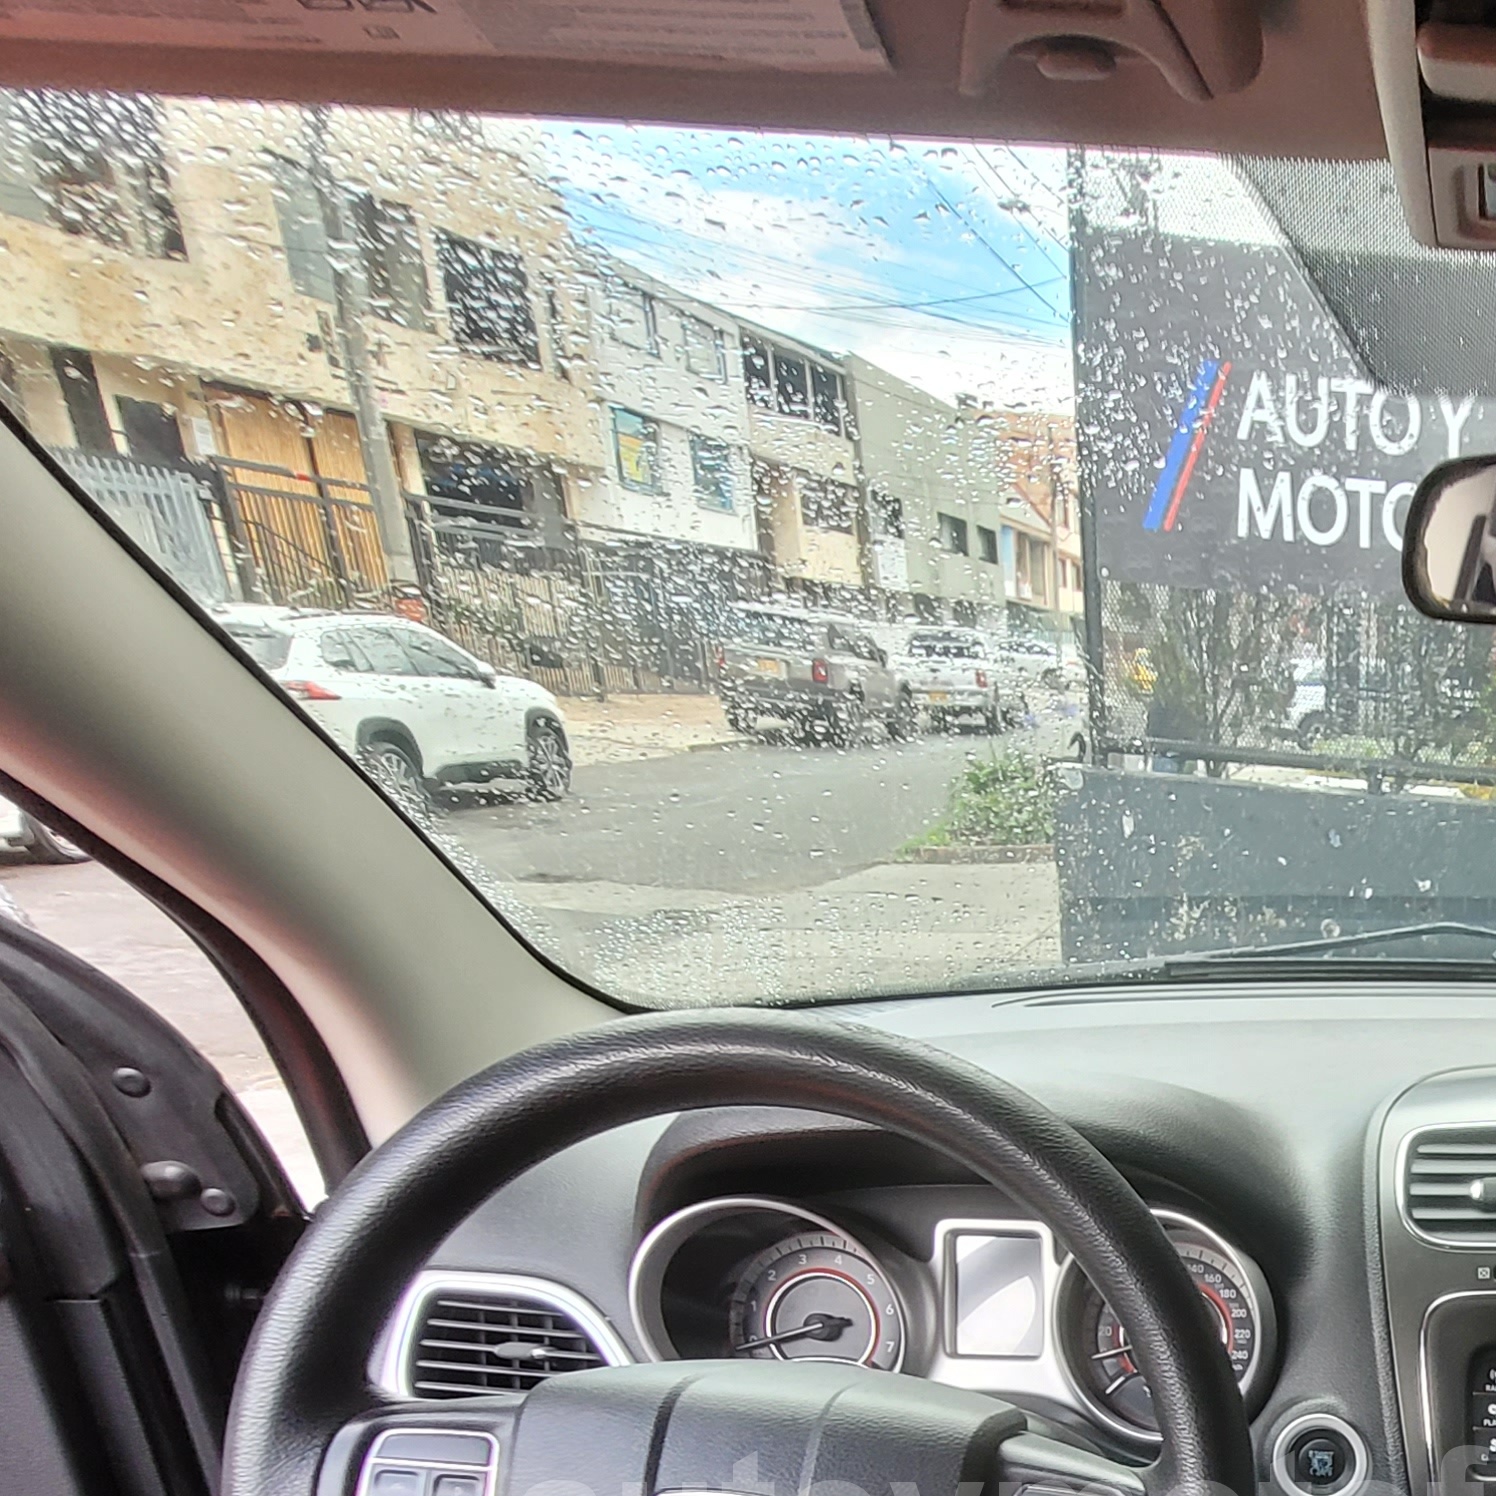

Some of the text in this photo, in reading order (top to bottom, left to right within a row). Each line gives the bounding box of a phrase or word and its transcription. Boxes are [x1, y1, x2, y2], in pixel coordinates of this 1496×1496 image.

[1236, 368, 1476, 460] AUTO Y
[798, 1254, 808, 1265] 3
[834, 1254, 843, 1266] 4
[768, 1269, 777, 1282] 2
[867, 1273, 876, 1286] 5
[1204, 1273, 1222, 1284] 160
[1219, 1288, 1237, 1299] 180
[750, 1300, 757, 1312] 1
[885, 1303, 895, 1316] 6
[1231, 1308, 1248, 1319] 200
[1234, 1328, 1251, 1340] 220
[885, 1340, 895, 1354] 7
[1231, 1350, 1249, 1361] 240
